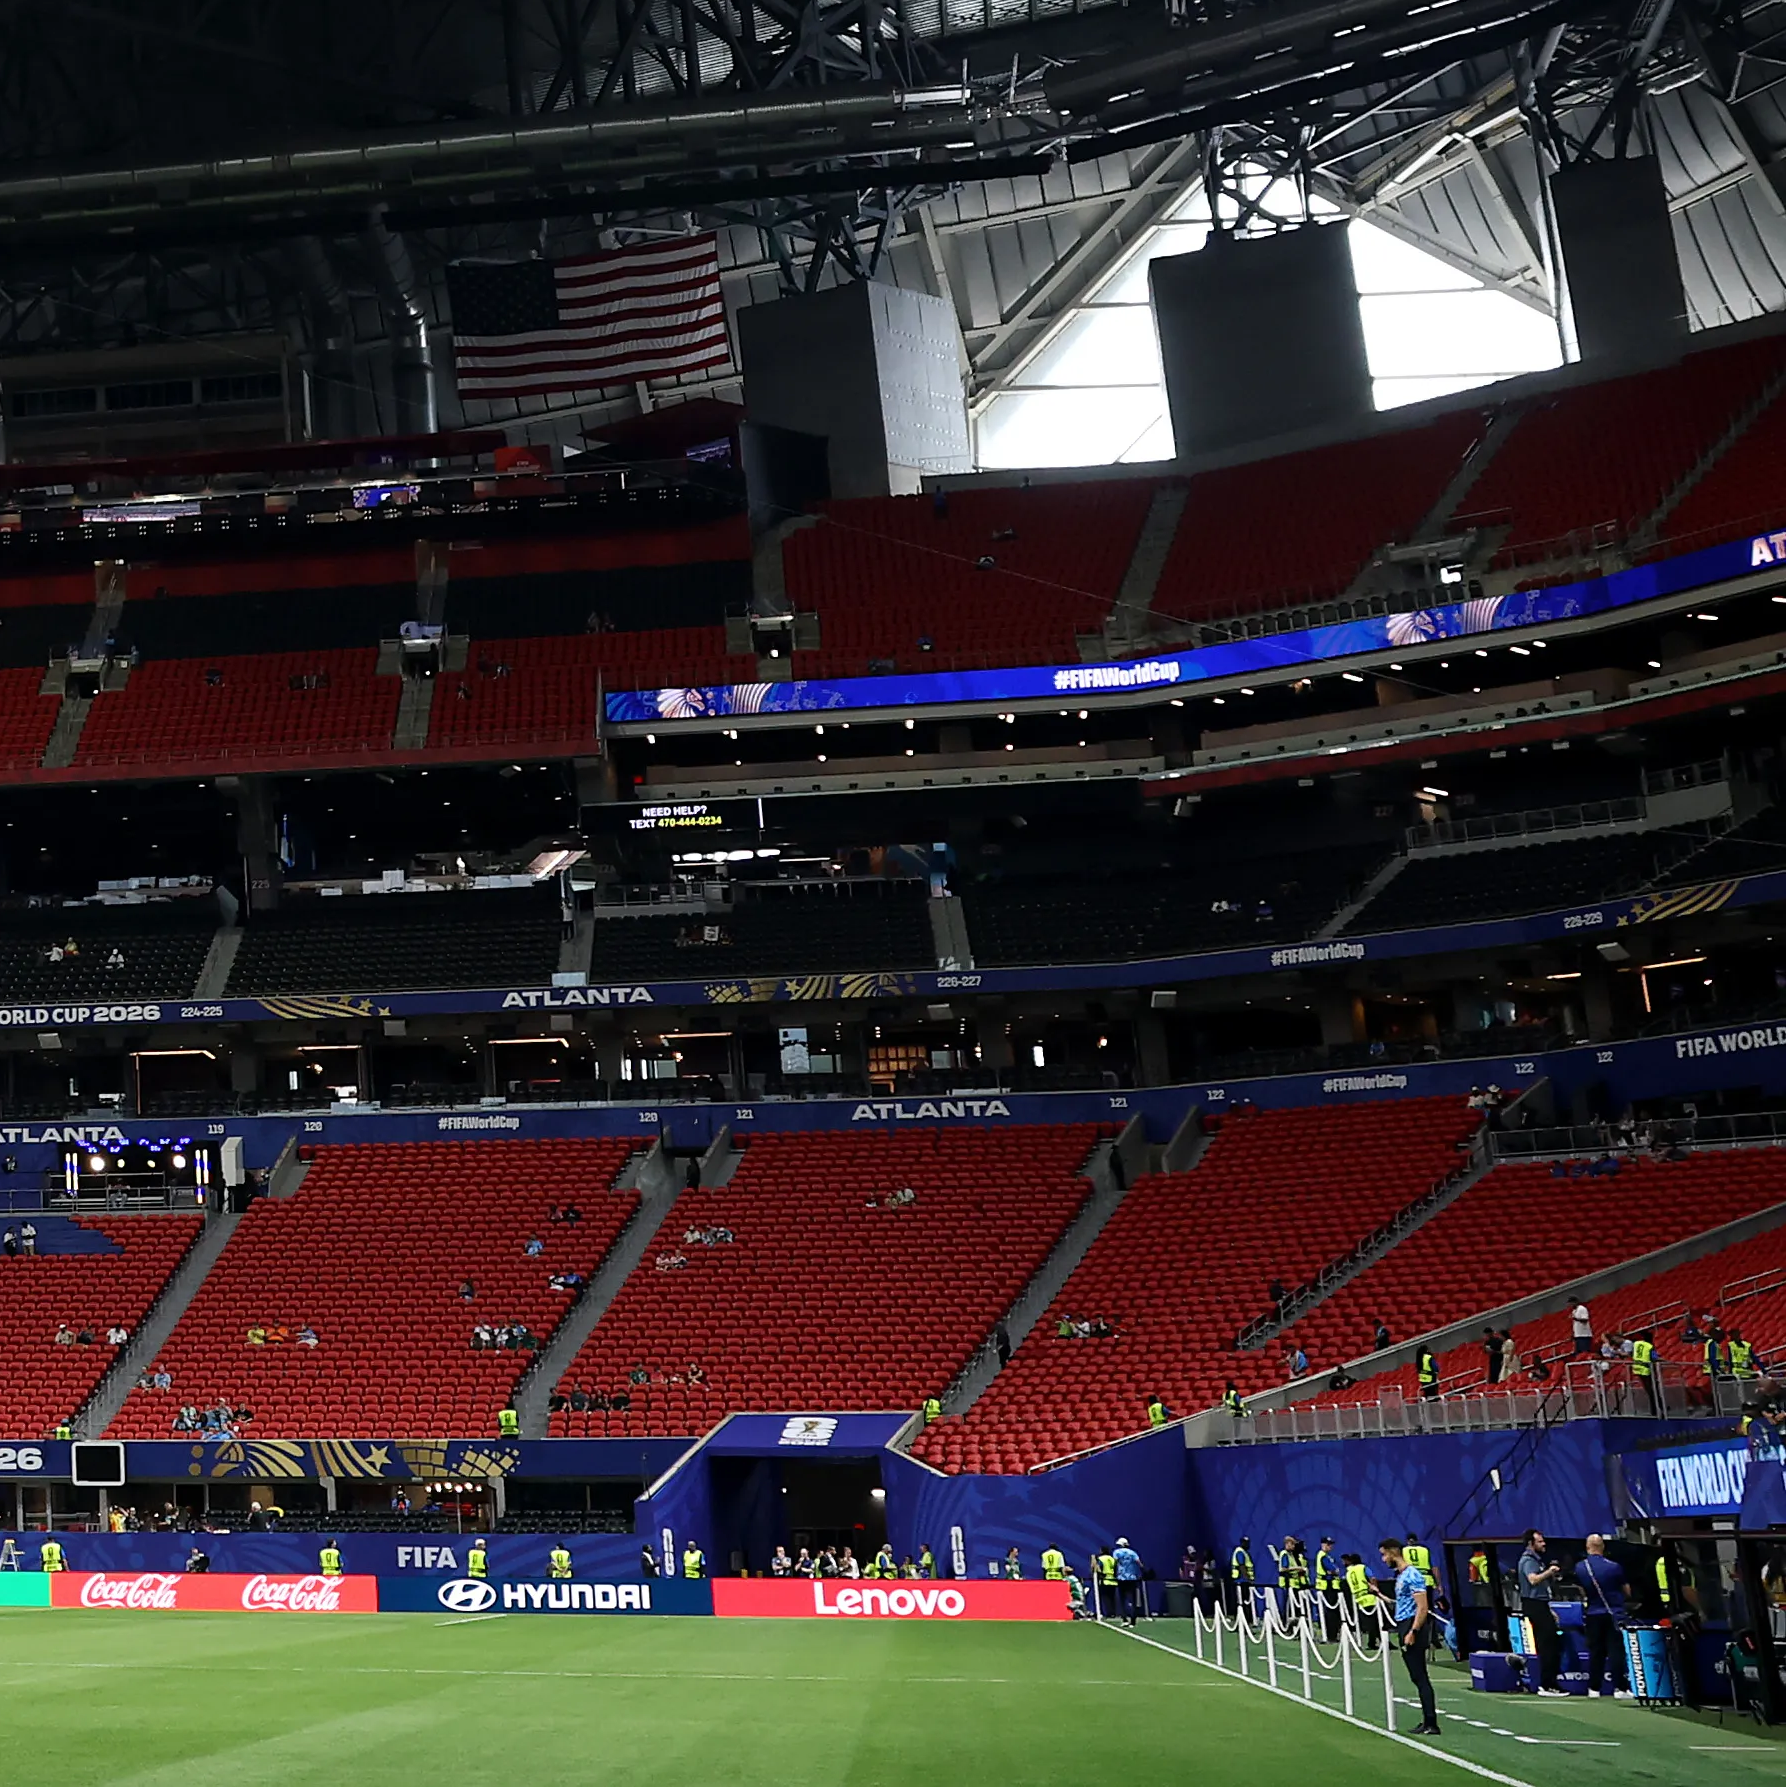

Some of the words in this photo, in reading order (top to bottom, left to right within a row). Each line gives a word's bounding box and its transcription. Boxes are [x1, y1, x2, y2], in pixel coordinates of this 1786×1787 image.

[1054, 662, 1179, 689] #FIFAWorldCup
[641, 806, 672, 818] NEED
[673, 804, 708, 816] HELP?
[629, 819, 656, 830] TEXT
[1269, 941, 1364, 966] #FIFAWorldCup
[937, 976, 981, 987] 226-227
[500, 984, 653, 1007] ATLANTA
[51, 1005, 90, 1023] CUP
[92, 1003, 160, 1021] 2026
[181, 1006, 222, 1017] 224-225
[1676, 1037, 1718, 1058] FIFA
[1515, 1063, 1534, 1073] 122
[1322, 1071, 1407, 1092] #FIFAWorldCup
[1207, 1090, 1225, 1100] 122
[851, 1099, 1010, 1120] ATLANTA
[438, 1116, 519, 1130] #FIFAWorldCup
[1655, 1457, 1690, 1509] FIFA
[1679, 1452, 1731, 1507] WORLD
[1727, 1448, 1750, 1505] CU
[398, 1547, 457, 1568] FIFA
[81, 1573, 181, 1608] Coca-Cola
[242, 1573, 344, 1610] Coca-Cola
[503, 1584, 650, 1609] HYUNDAI
[814, 1582, 965, 1616] Lenovo
